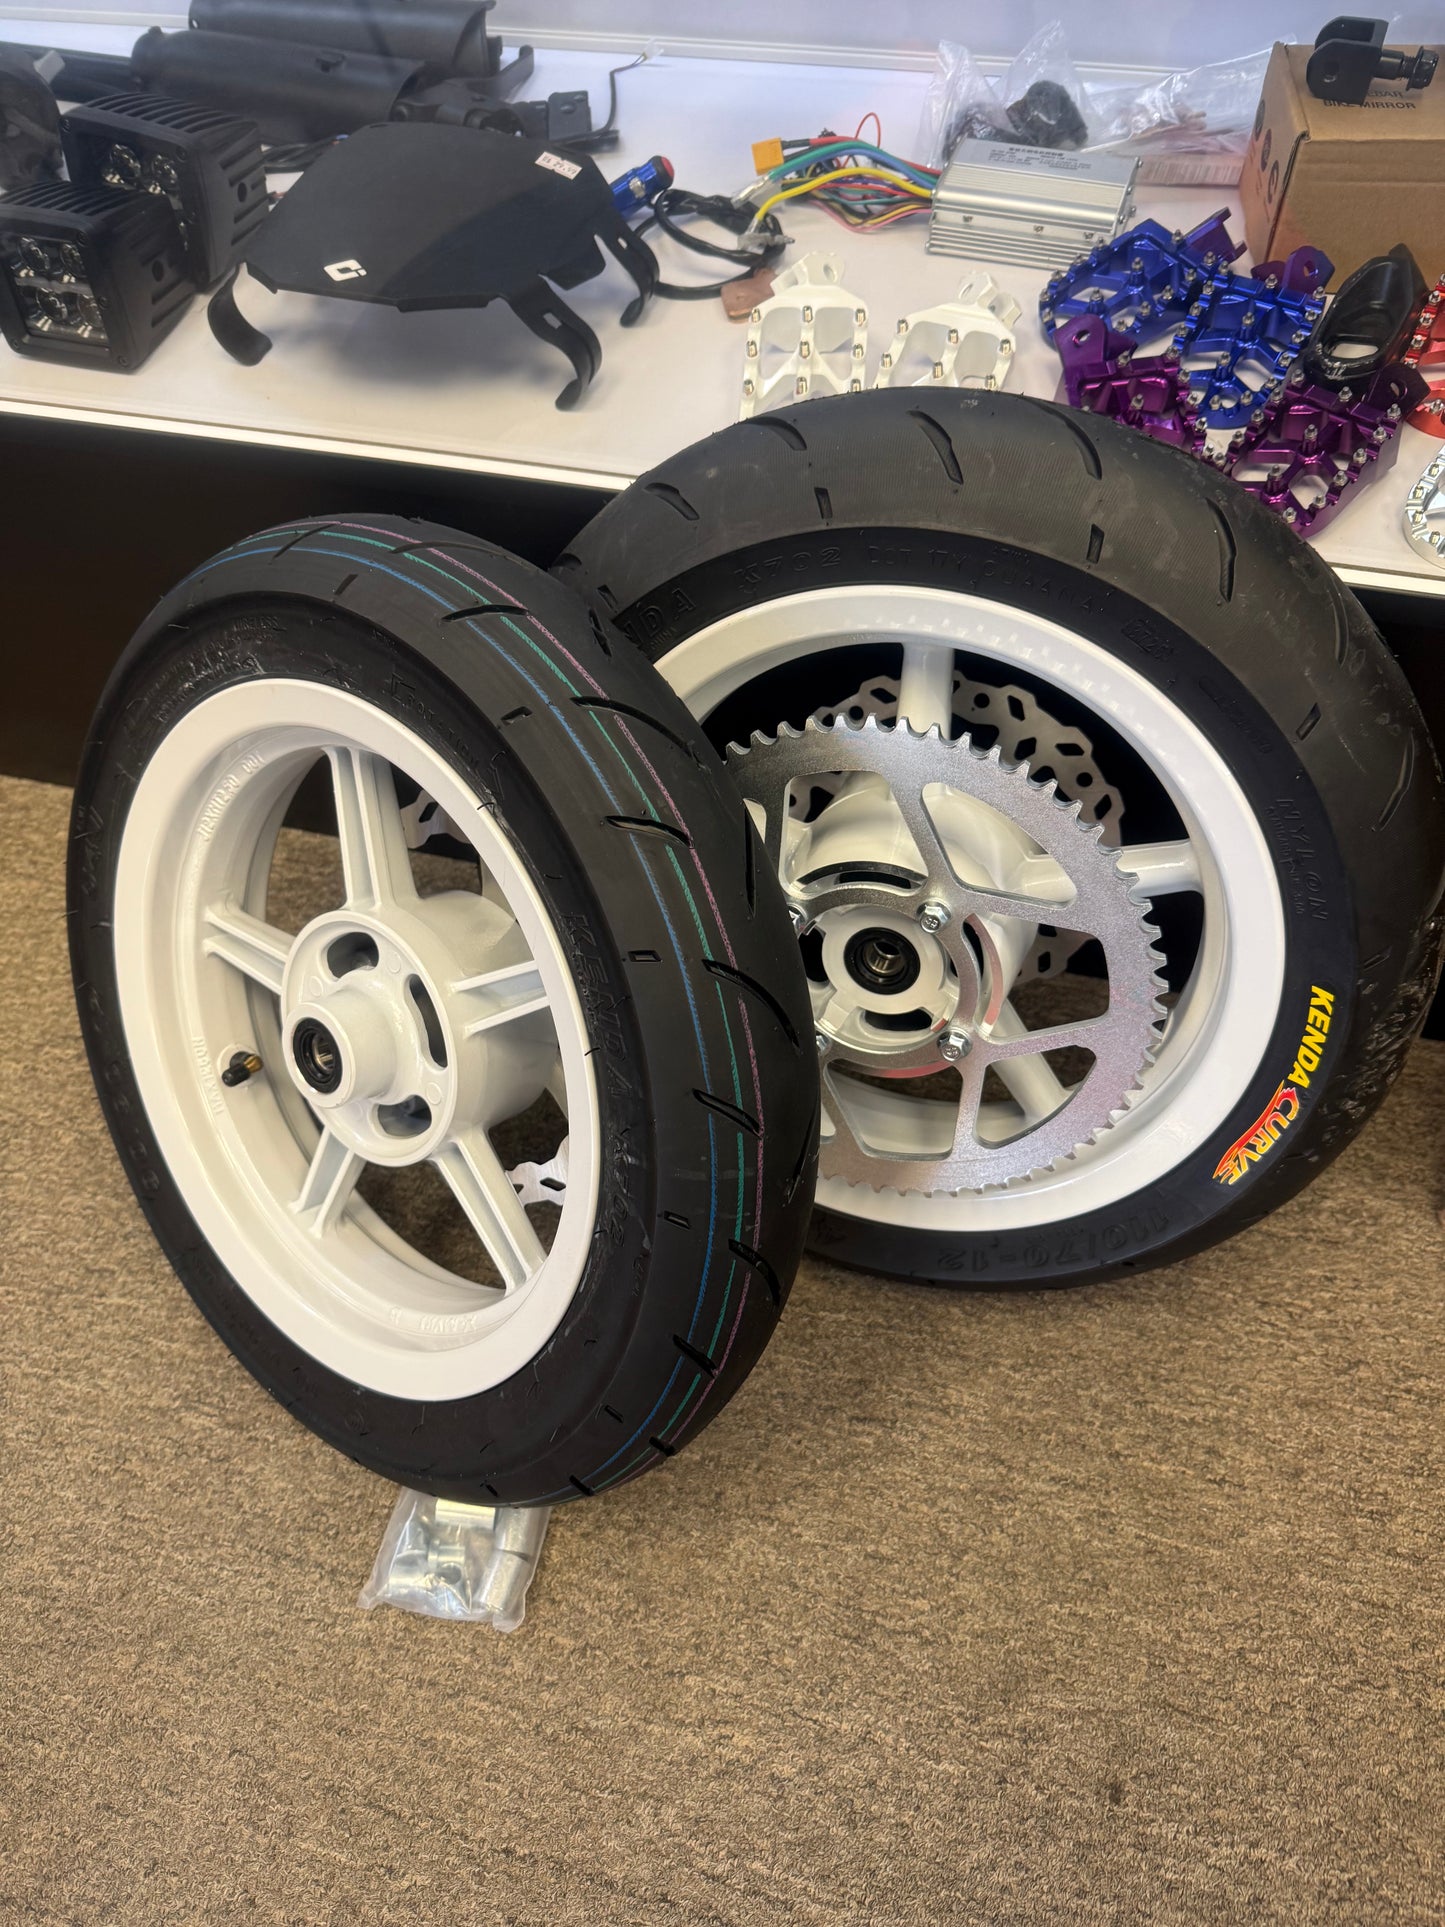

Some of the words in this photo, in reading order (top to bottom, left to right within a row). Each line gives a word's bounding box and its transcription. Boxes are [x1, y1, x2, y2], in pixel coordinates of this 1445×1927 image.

[1361, 101, 1416, 109] MIRROR
[1276, 799, 1328, 920] NYLON
[1287, 985, 1335, 1089] KENDA
[1212, 1082, 1300, 1186] CURVE
